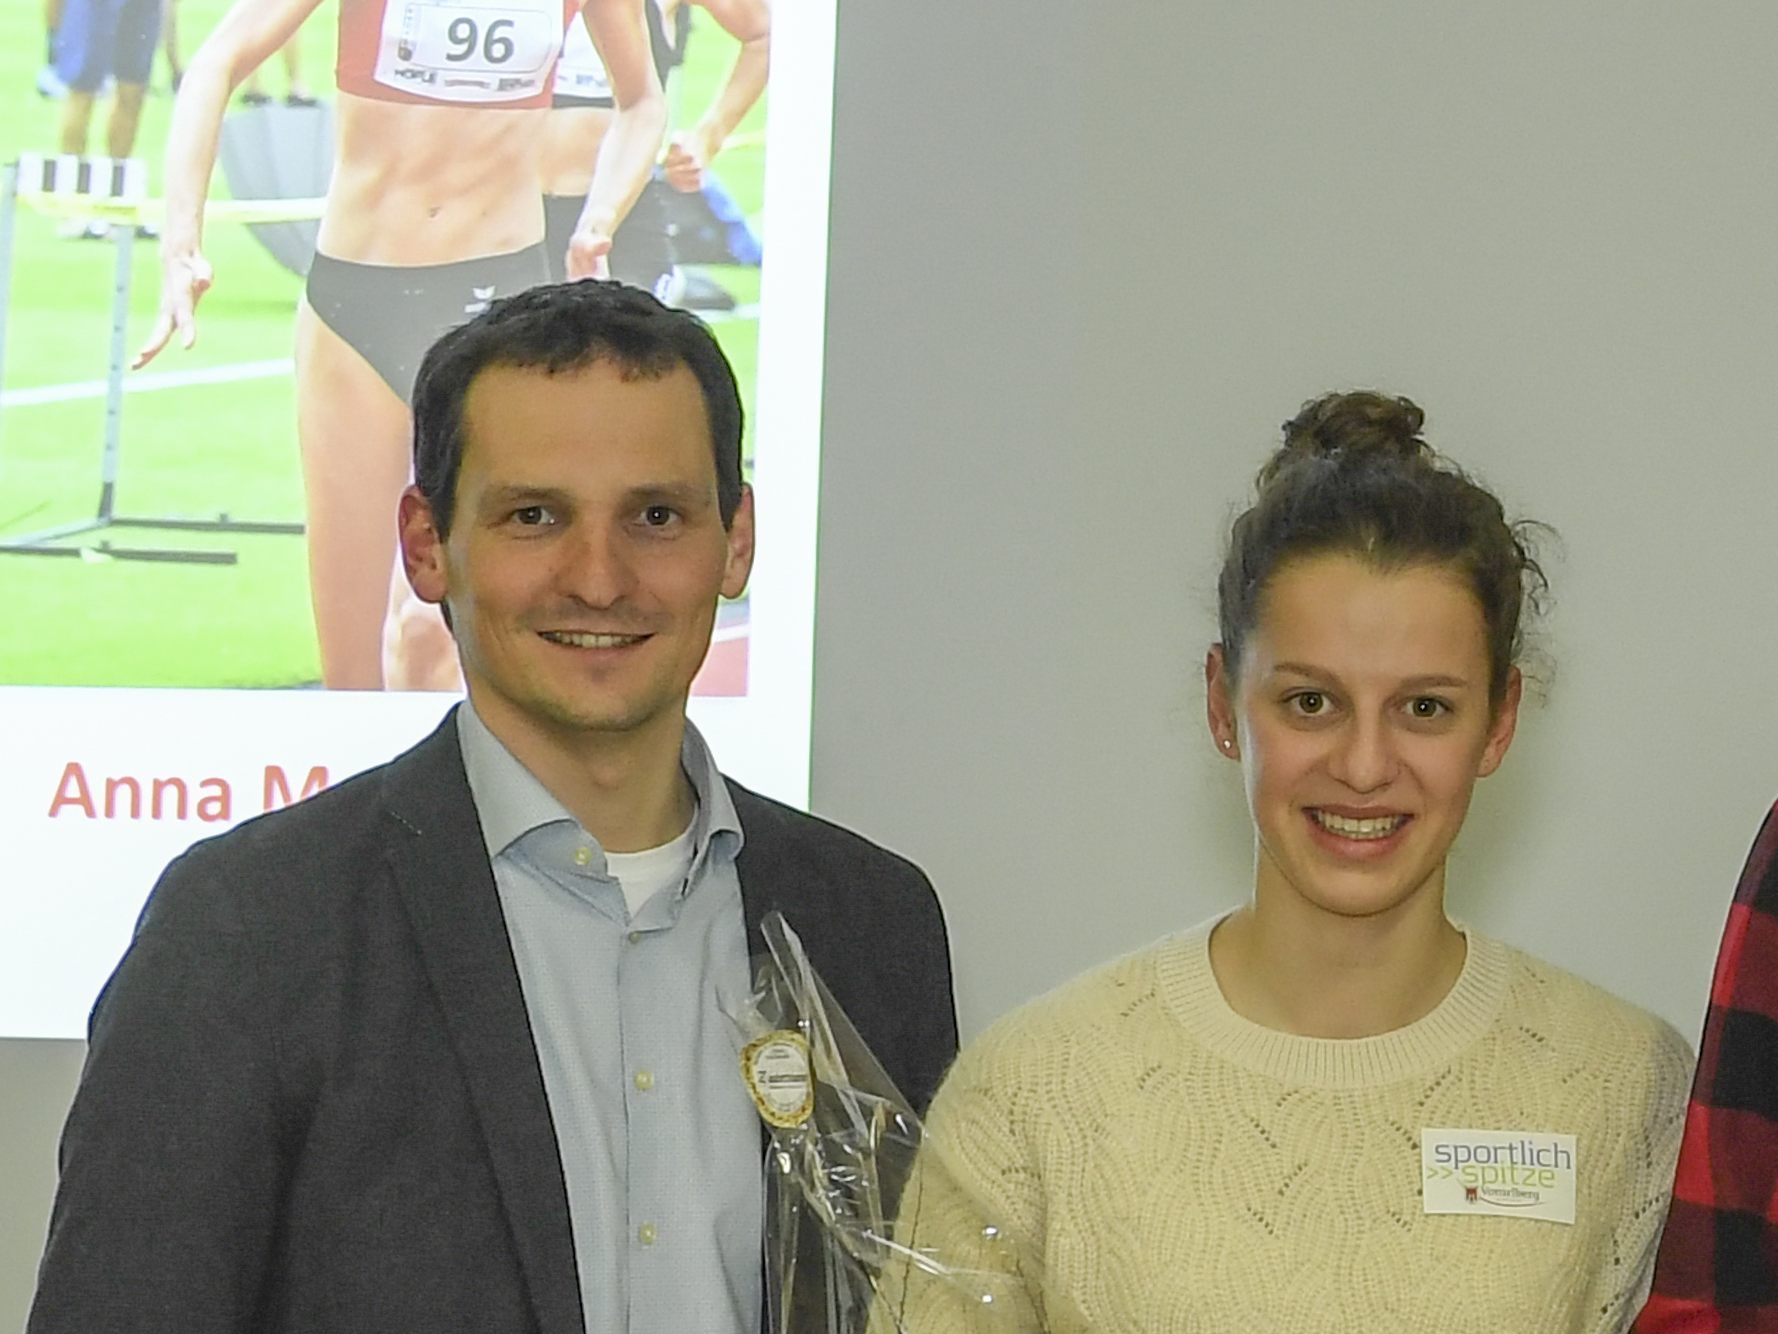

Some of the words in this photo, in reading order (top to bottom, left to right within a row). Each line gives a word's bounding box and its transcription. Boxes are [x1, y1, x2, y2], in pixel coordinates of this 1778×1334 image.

[445, 17, 515, 64] 96
[48, 762, 232, 822] Anna
[1434, 1140, 1571, 1170] sportlich
[1461, 1162, 1556, 1191] spitze
